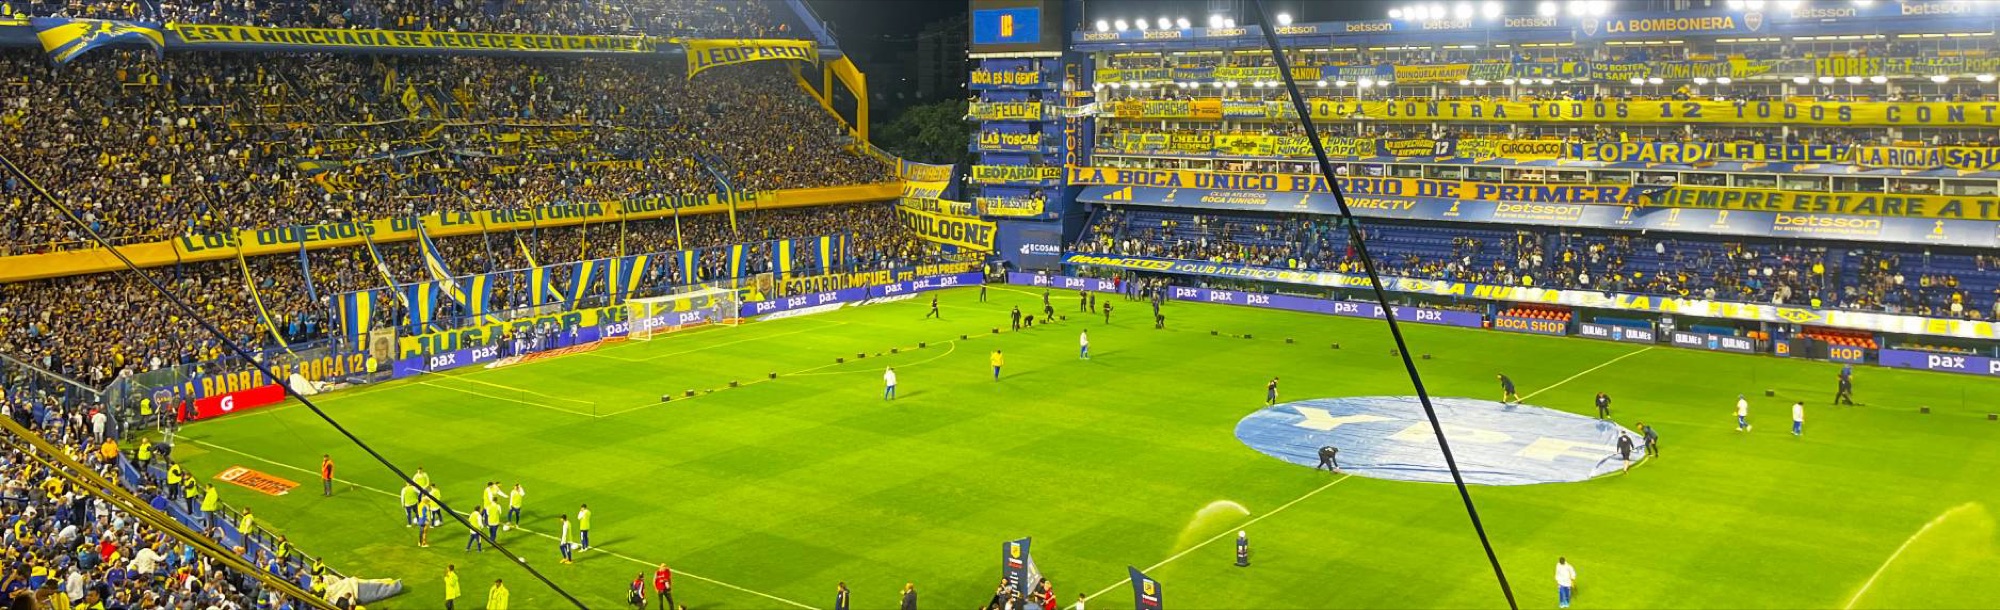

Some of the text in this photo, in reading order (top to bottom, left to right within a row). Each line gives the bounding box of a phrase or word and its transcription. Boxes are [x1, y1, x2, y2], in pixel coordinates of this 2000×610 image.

[1902, 2, 1970, 15] betsson
[1346, 21, 1391, 31] betsson
[1423, 18, 1471, 30] betsson
[1505, 16, 1556, 27] betsson
[1606, 16, 1735, 32] LA BOMBONERA
[1084, 31, 1119, 41] betsson
[1144, 29, 1181, 40] betsson
[1207, 28, 1246, 38] betsson
[1274, 24, 1316, 35] betsson
[183, 26, 255, 42] ESTA
[259, 29, 392, 46] HINCHADA
[396, 34, 426, 47] SE
[428, 35, 517, 49] MERECE
[696, 45, 812, 67] LEOPARDI
[1592, 62, 1608, 71] LOS
[1814, 57, 1881, 77] FLORES
[972, 71, 991, 84] BOCA
[1015, 71, 1038, 85] GENTE
[1387, 103, 1506, 118] CONTRA
[1529, 103, 1628, 118] TODOS
[1659, 103, 1701, 118] 12
[1734, 103, 1851, 120] TODOS
[980, 132, 1039, 145] LAS TOSCAS
[1501, 144, 1559, 154] CIRCOLOCO
[1566, 144, 1713, 163] LEOPARDI
[1861, 148, 1939, 167] LA RIOJA
[976, 167, 1037, 179] LEOPARDI
[1070, 168, 1638, 204] LA BOCA UNICO BARRIO DE PRIMERA
[1200, 195, 1268, 205] BOCA JUNIORS
[1343, 196, 1416, 211] DIRECTV
[1658, 189, 1785, 210] IEMPRE
[1937, 199, 1962, 218] A
[1495, 201, 1584, 216] betsson
[181, 232, 241, 252] LOS
[440, 210, 475, 225] LA
[489, 203, 604, 225] HISTORIA
[1774, 213, 1881, 229] betsson
[1029, 243, 1061, 253] ECOSAN
[916, 263, 939, 276] RAFA
[1182, 263, 1216, 274] CLUB
[775, 271, 850, 298] LEOPARDI
[849, 269, 914, 289] MIGUEL PTE
[913, 278, 931, 291] pax
[941, 273, 958, 287] pax
[1065, 277, 1085, 288] pax
[885, 282, 903, 294] pax
[1176, 287, 1197, 298] pax
[788, 295, 807, 309] pax
[819, 290, 838, 304] pax
[1210, 291, 1233, 302] pax
[1246, 294, 1270, 305] pax
[755, 298, 777, 312] pax
[1334, 302, 1358, 314] pax
[1416, 309, 1441, 321] pax
[607, 320, 629, 334] pax
[1495, 318, 1565, 334] BOCA SHOP
[1582, 324, 1607, 337] QUILMES
[1625, 329, 1651, 342] QUILMES
[1674, 333, 1702, 345] QUILMES
[1721, 337, 1750, 350] QUILMES
[472, 346, 498, 365] pax
[1830, 347, 1864, 360] HOP
[430, 353, 456, 370] pax
[1927, 353, 1966, 370] pax
[202, 369, 265, 398] BARRA
[299, 354, 345, 382] BOCA
[347, 353, 365, 374] 12
[220, 395, 234, 411] G
[1288, 405, 1625, 462] YPF
